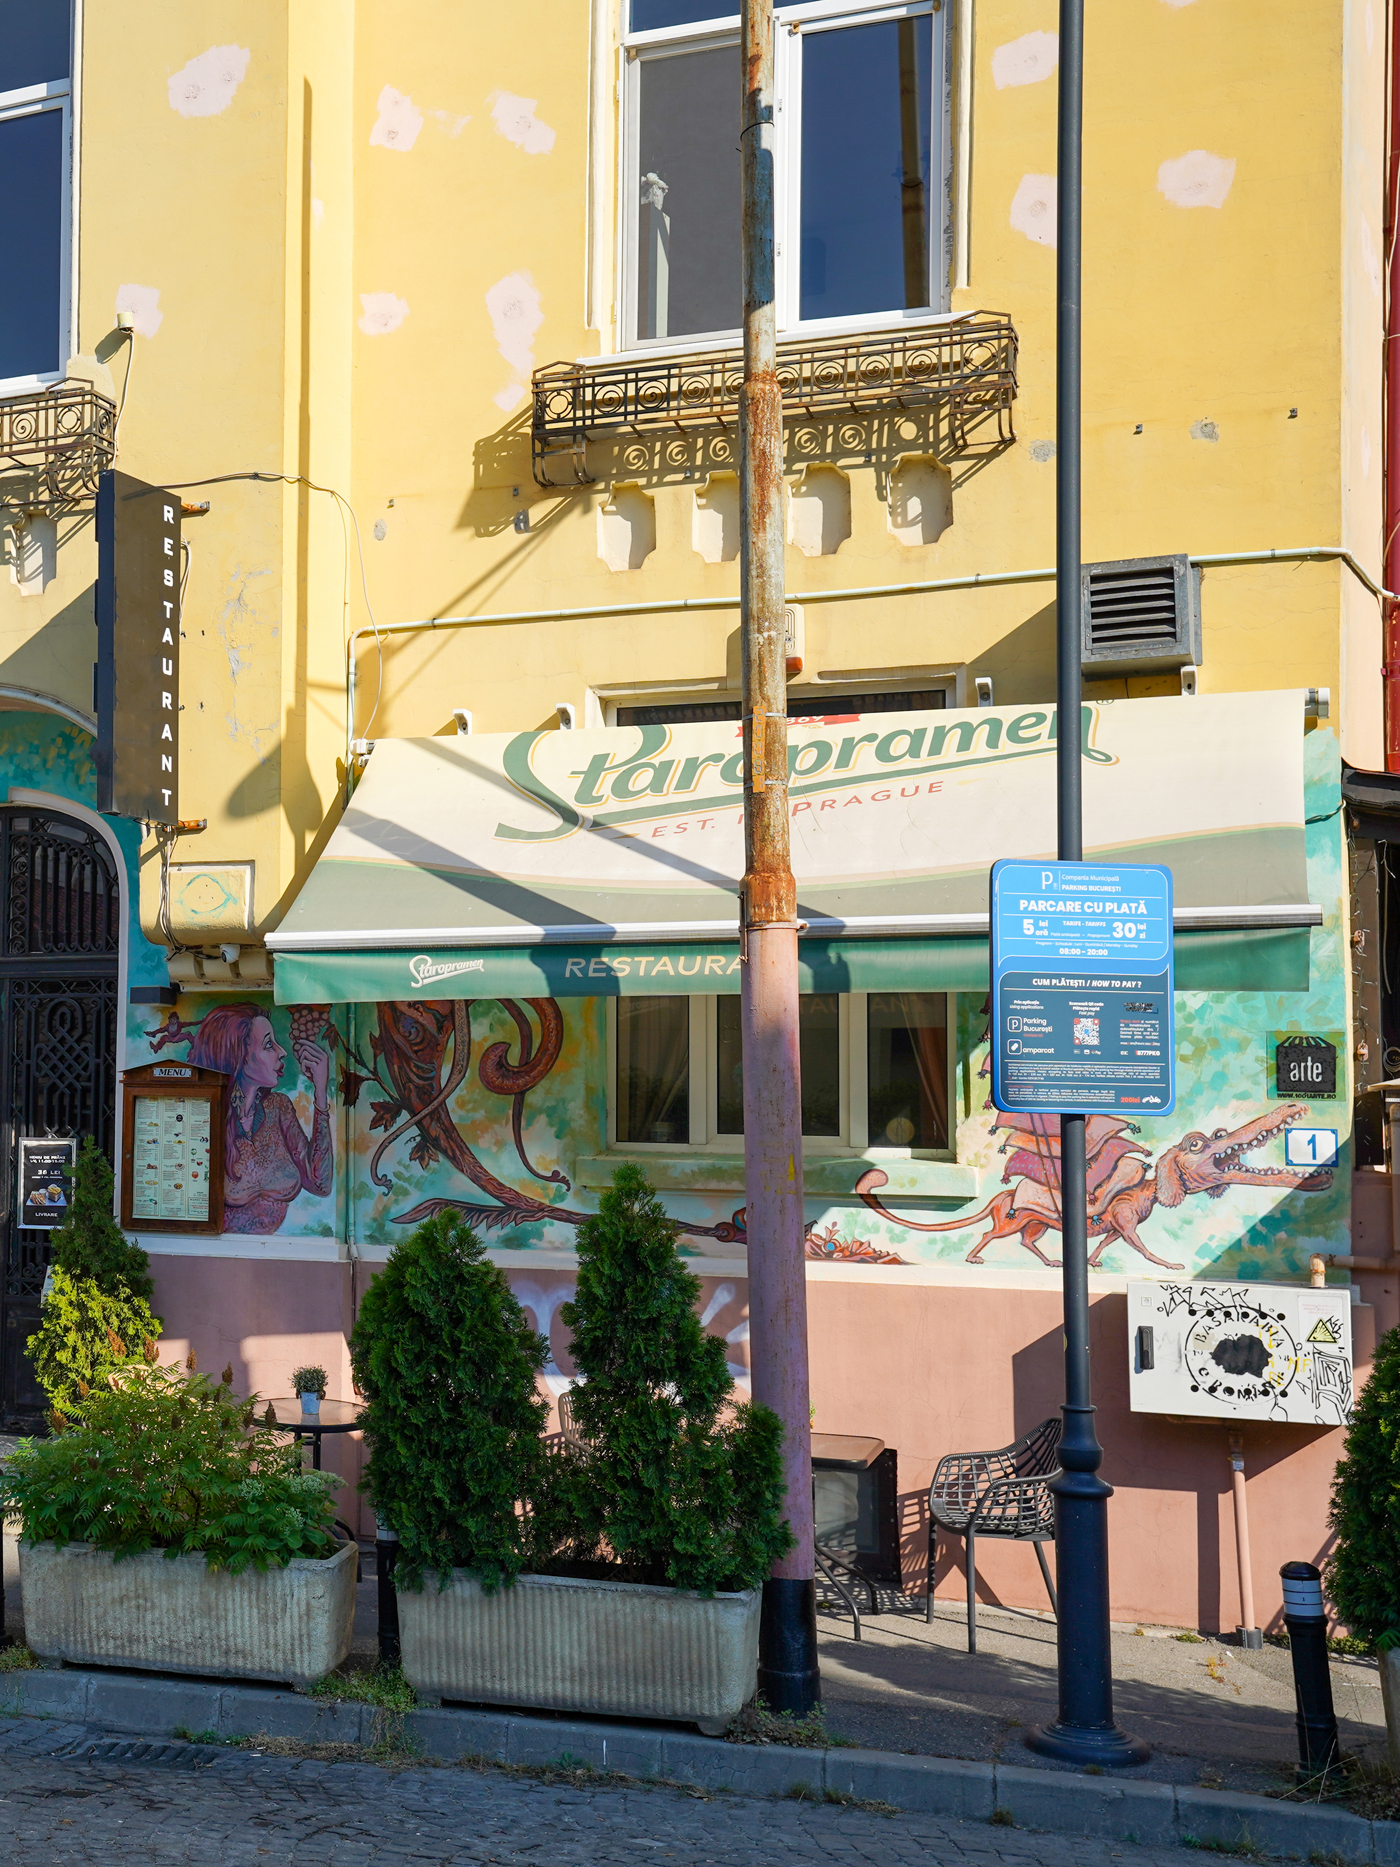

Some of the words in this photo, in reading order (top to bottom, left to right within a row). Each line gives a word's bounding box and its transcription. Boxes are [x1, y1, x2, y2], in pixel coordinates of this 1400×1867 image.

[162, 505, 174, 806] RESTAURANT
[651, 819, 715, 838] EST.
[791, 781, 944, 817] PRAGUE
[1089, 885, 1121, 893] BUCUREȘTI
[1020, 900, 1082, 912] PARCARE
[1084, 902, 1103, 912] CU
[1106, 900, 1147, 914] PLATĂ
[1023, 919, 1034, 935] 5
[1113, 922, 1136, 938] 30
[409, 955, 484, 988] Staropramen
[565, 954, 742, 978] RESTAURA
[1052, 978, 1085, 987] PLĂTEȘTI
[1024, 1018, 1047, 1026] Parking
[1290, 1056, 1322, 1082] arte
[1307, 1134, 1316, 1160] 1
